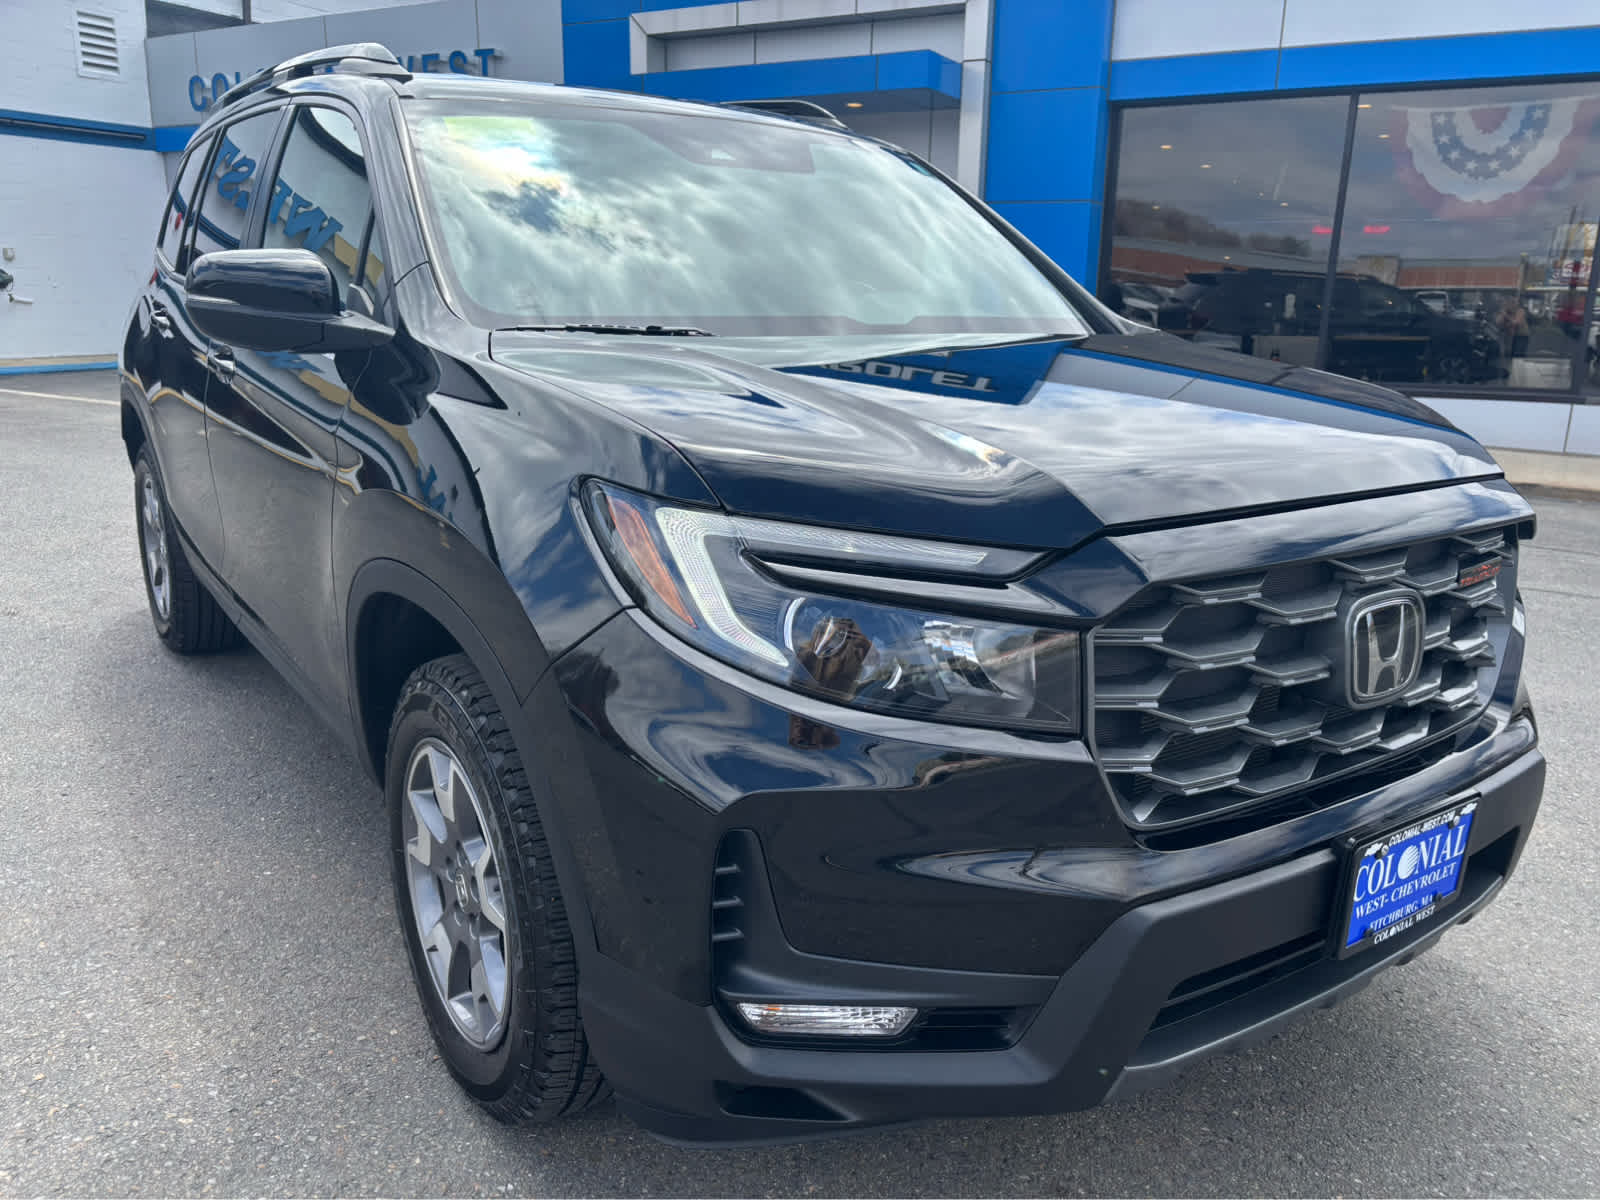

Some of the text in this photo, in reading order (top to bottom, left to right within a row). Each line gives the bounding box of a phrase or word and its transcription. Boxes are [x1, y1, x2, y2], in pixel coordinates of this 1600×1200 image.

[1353, 824, 1466, 902] COLONIAL
[1391, 862, 1457, 901] CHEVROLET
[1373, 904, 1436, 945] COLONIAL WEST
